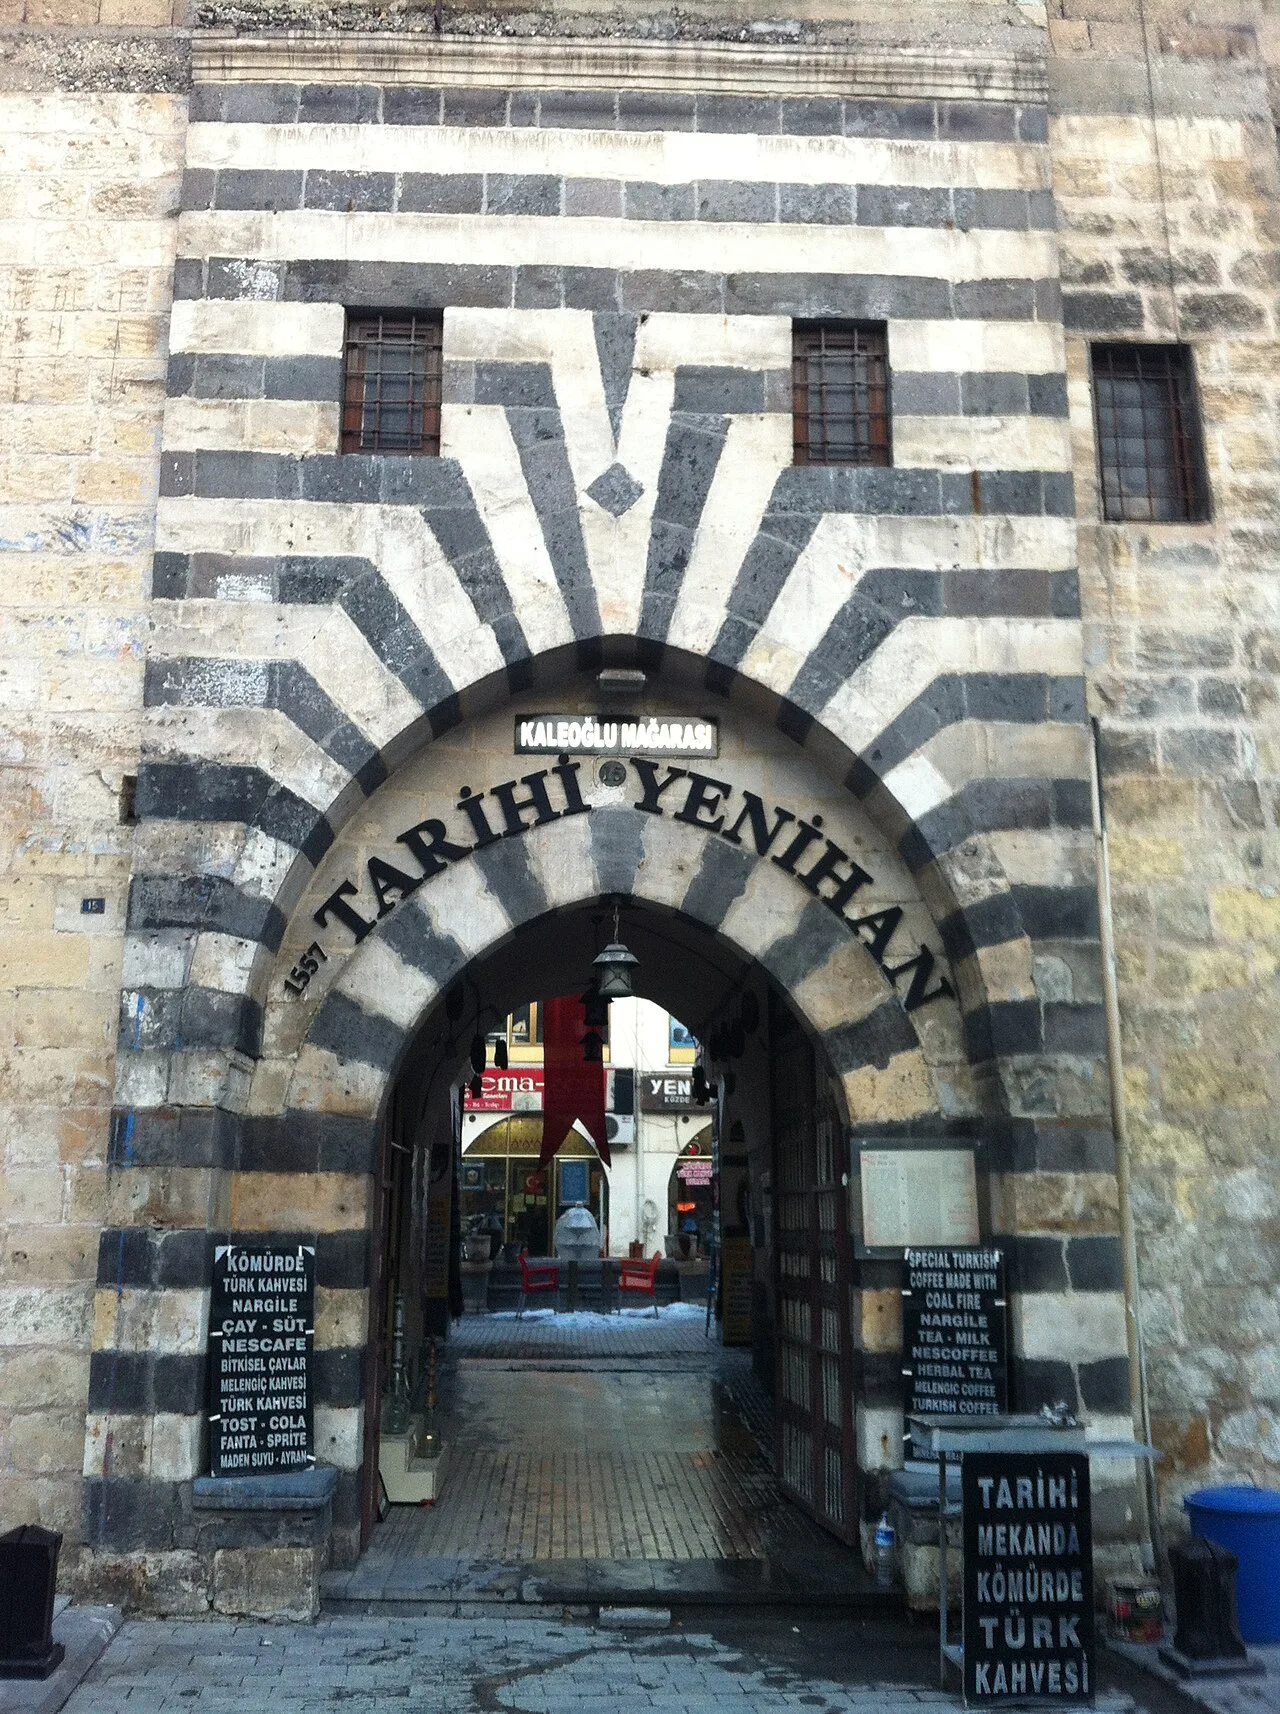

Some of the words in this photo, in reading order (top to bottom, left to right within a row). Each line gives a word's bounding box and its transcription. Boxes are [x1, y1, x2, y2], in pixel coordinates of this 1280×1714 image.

[521, 717, 618, 747] KALEOĞLU
[621, 718, 712, 749] MAĞARASI
[315, 752, 592, 944] TARİHİ
[630, 756, 959, 1013] YENİHAN
[284, 941, 328, 997] 1557
[650, 1078, 694, 1095] YEN
[228, 1251, 304, 1272] KÖMÜRDE
[910, 1251, 950, 1269] SPECIAL
[953, 1252, 999, 1270] TURKISH
[223, 1275, 254, 1292] TÜRK
[258, 1274, 307, 1293] KAHVESİ
[910, 1272, 943, 1289] COFFEE
[946, 1272, 972, 1289] MADE
[974, 1274, 997, 1290] WITH
[233, 1296, 297, 1312] NARGİLE
[926, 1292, 954, 1309] COAL
[957, 1293, 980, 1310] FIRE
[223, 1319, 257, 1336] ÇAY
[273, 1316, 306, 1332] SÜT
[920, 1311, 988, 1329] NARGİLE
[222, 1338, 306, 1352] NESCAFE
[918, 1330, 943, 1344] TEA
[956, 1331, 990, 1346] MILK
[912, 1346, 998, 1363] NESCOFFEE
[221, 1355, 266, 1372] BİTKİSEL
[269, 1357, 306, 1374] ÇAYLAR
[918, 1364, 964, 1379] HERBAL
[968, 1365, 992, 1380] TEA
[221, 1375, 267, 1395] MELENGİÇ
[269, 1372, 306, 1390] KAHVESİ
[961, 1382, 995, 1398] COFFEE
[220, 1396, 253, 1412] TÜRK
[257, 1392, 306, 1410] KAHVESİ
[913, 1397, 956, 1413] TURKISH
[959, 1398, 999, 1415] COFFEE
[220, 1418, 257, 1432] TOST
[270, 1415, 306, 1429] COLA
[221, 1435, 257, 1450] FANTA
[267, 1430, 306, 1447] SPRİTE
[220, 1454, 249, 1469] MADEN
[252, 1452, 274, 1467] SUYU
[280, 1450, 307, 1465] AYRAN
[978, 1466, 1078, 1509] TARİHİ
[978, 1523, 1080, 1556] MEKANDA
[977, 1561, 1083, 1603] KÖMÜRDE
[979, 1608, 1082, 1649] TÜRK
[975, 1649, 1089, 1695] KAHVESİ
